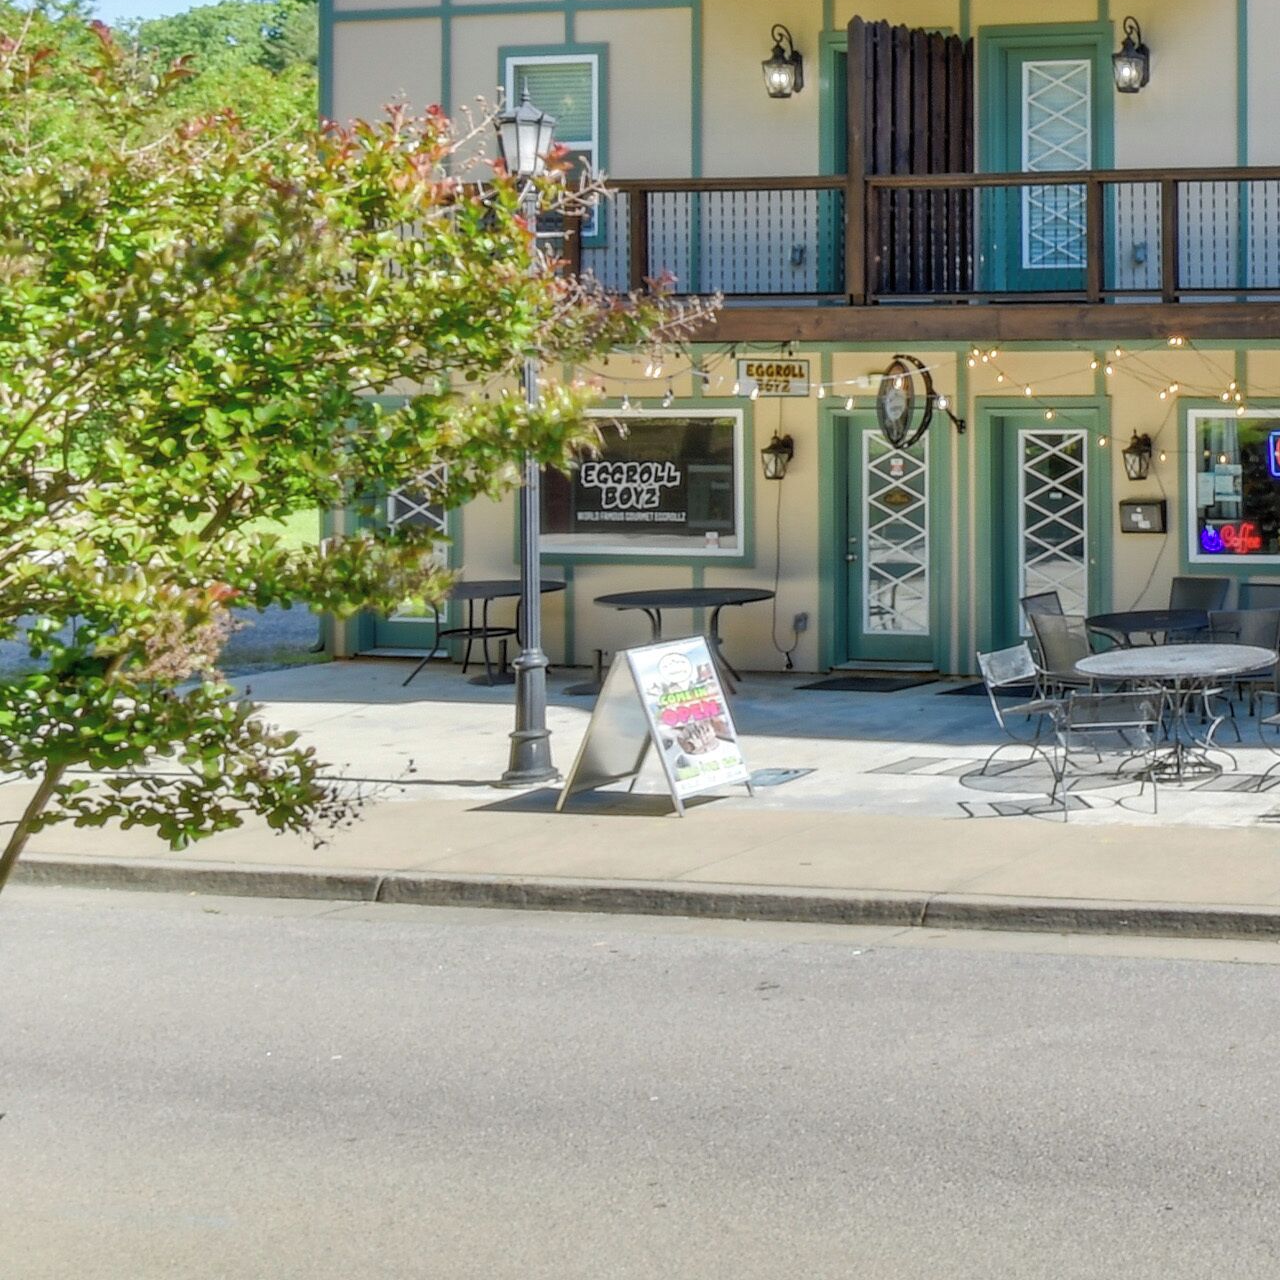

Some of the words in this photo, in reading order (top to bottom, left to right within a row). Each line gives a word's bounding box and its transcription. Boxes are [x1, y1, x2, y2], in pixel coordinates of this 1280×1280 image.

[746, 363, 805, 378] EGGROLL
[581, 461, 681, 488] EGGROLL
[602, 484, 660, 509] BOYZ
[1219, 521, 1262, 554] Coffee
[662, 699, 722, 726] OPEN
